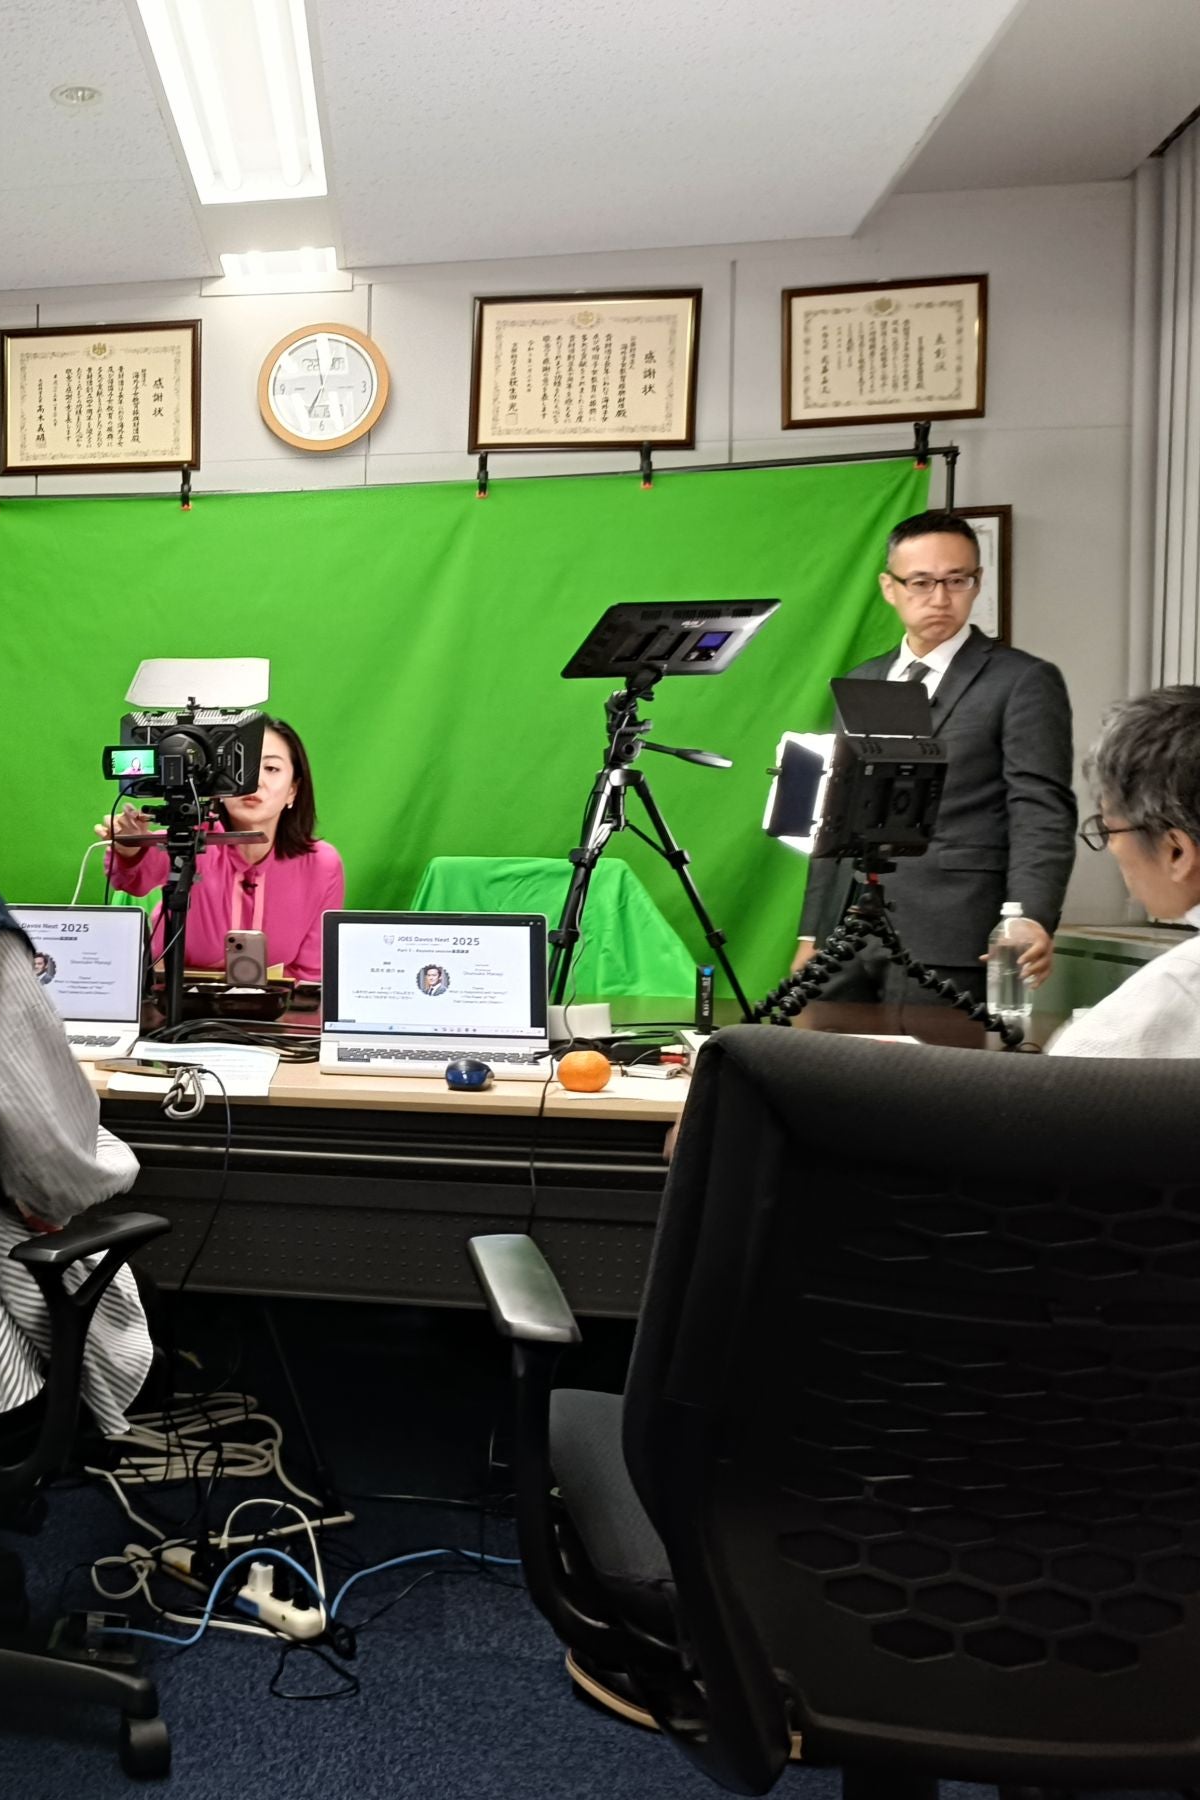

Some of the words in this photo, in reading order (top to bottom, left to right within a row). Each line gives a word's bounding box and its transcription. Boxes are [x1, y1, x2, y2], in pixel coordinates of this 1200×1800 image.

[360, 380, 367, 393] 3
[152, 378, 164, 418] 感謝状
[60, 923, 89, 933] 2025
[452, 937, 480, 946] 2025
